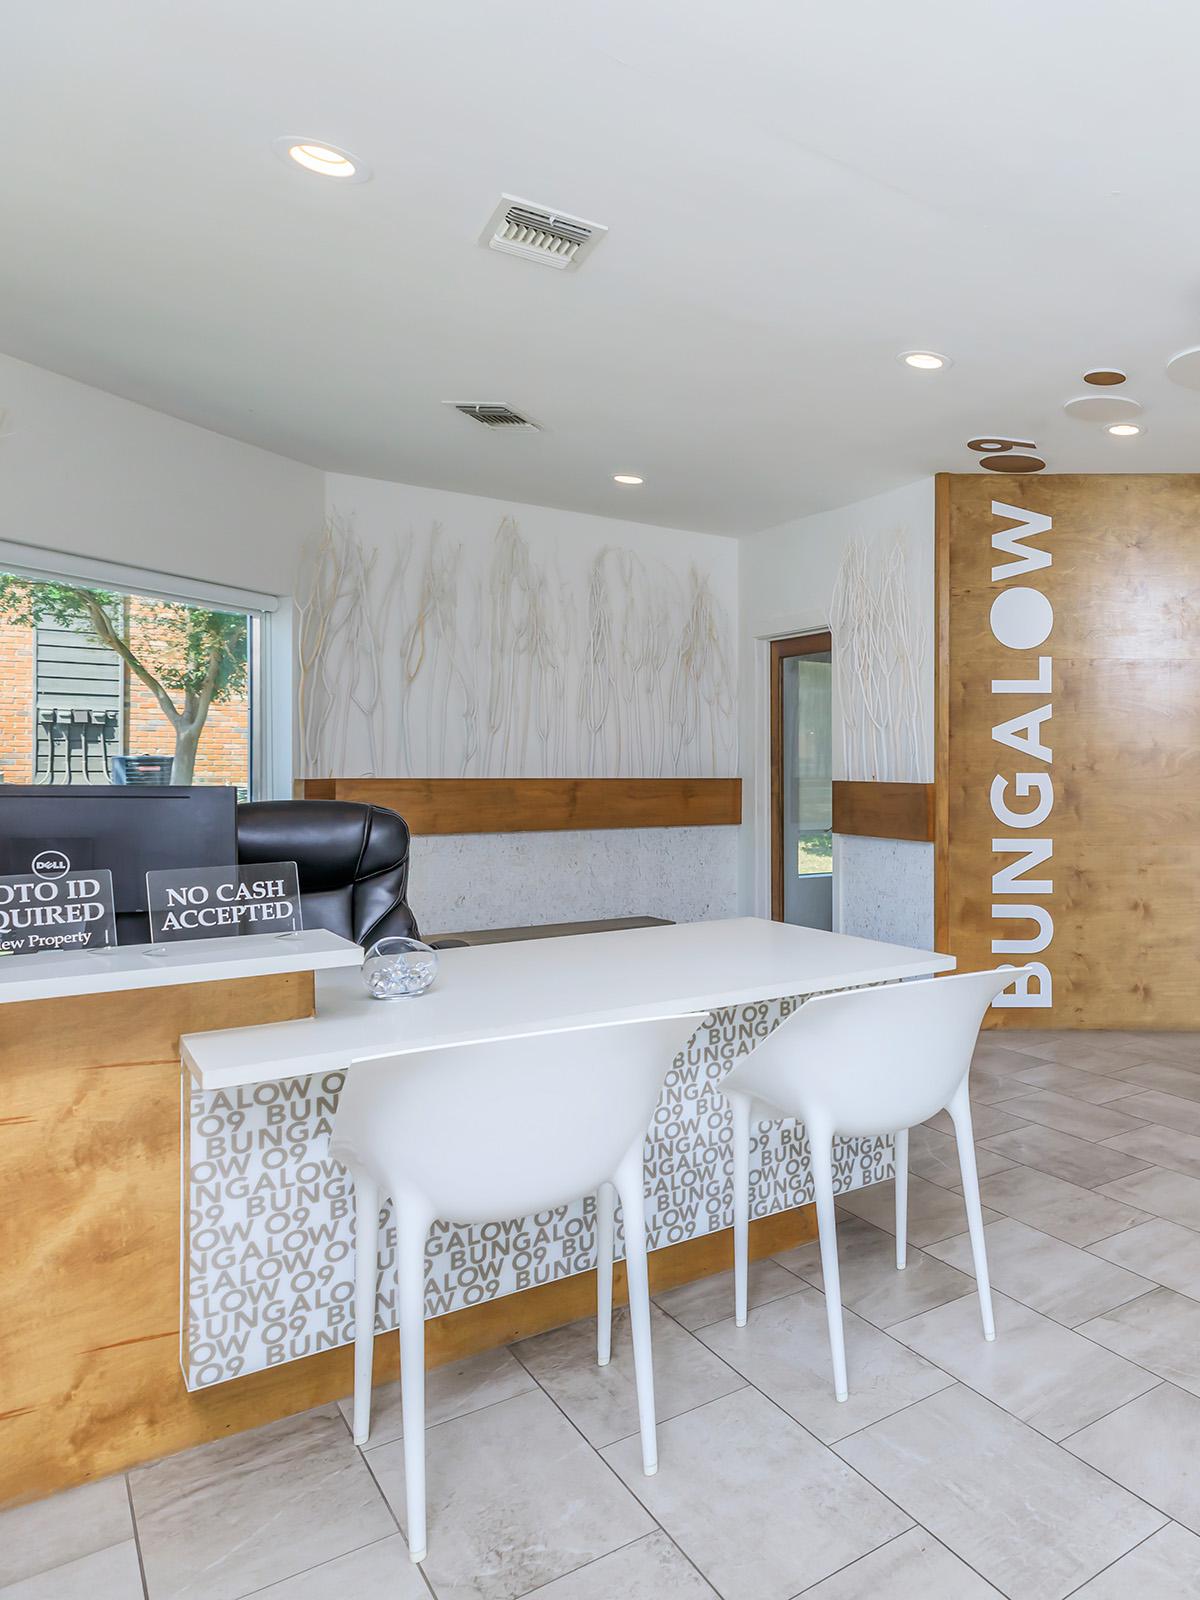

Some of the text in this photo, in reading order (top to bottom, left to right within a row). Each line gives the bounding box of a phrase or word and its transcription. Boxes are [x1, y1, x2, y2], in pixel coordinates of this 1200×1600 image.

[989, 499, 1054, 1008] BUNGALOW
[36, 861, 66, 870] DELL
[66, 879, 101, 899] ID
[166, 879, 286, 907] NO CASH
[161, 901, 294, 931] ACCEPTED
[28, 932, 92, 948] Property
[192, 1218, 253, 1252] OW
